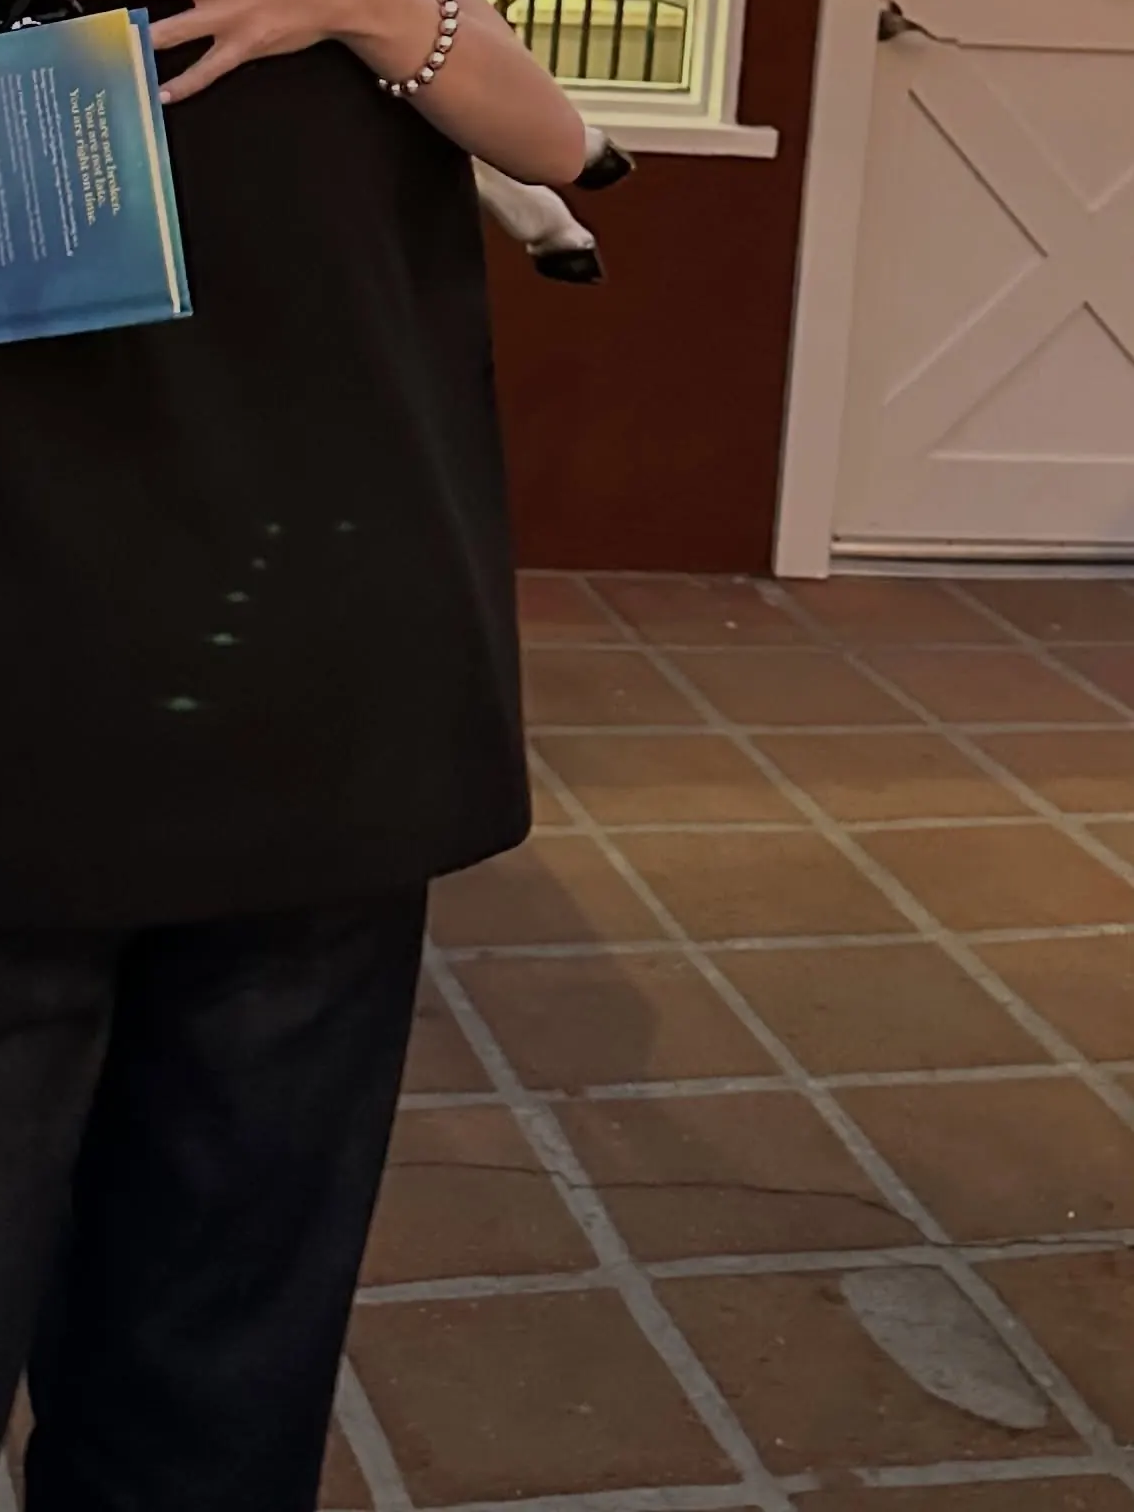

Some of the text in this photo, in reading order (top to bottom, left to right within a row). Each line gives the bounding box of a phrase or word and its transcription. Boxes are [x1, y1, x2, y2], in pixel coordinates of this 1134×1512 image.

[69, 87, 79, 114] You
[95, 89, 106, 116] You
[72, 115, 83, 137] are
[84, 102, 95, 129] You
[98, 117, 108, 139] are
[87, 130, 98, 153] are
[102, 139, 114, 164] not
[76, 138, 90, 171] right
[91, 153, 103, 176] not
[82, 172, 91, 190] on
